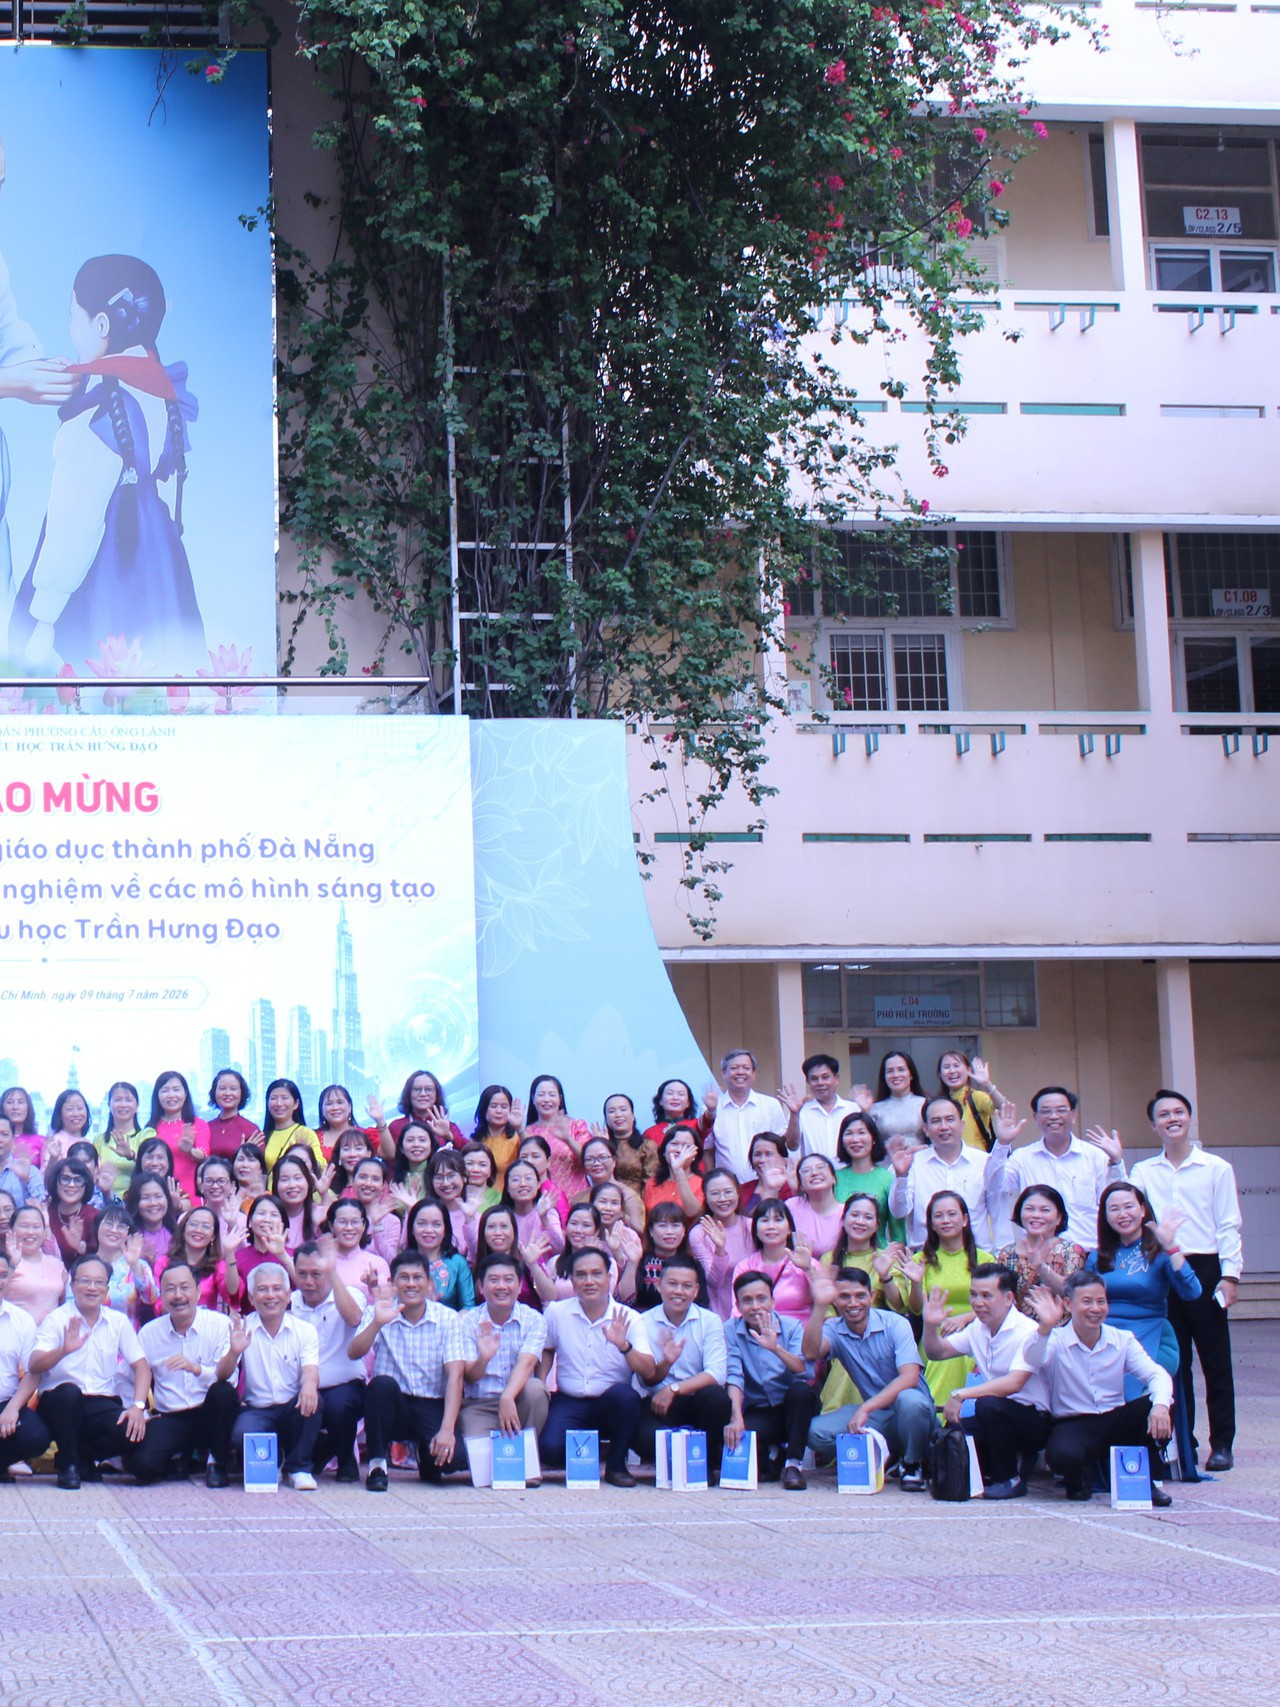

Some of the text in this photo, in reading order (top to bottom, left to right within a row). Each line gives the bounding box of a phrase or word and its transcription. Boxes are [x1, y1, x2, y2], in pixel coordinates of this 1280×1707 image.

[1195, 208, 1229, 221] C2.13
[1217, 222, 1241, 234] 2/5
[1223, 590, 1258, 603] C1.08
[1245, 605, 1271, 617] 2/3
[16, 741, 45, 754] HỌC
[87, 740, 125, 752] HƯNG
[129, 741, 159, 754] ĐẠO
[42, 772, 159, 813] MỪNG
[55, 838, 105, 865] dục
[111, 837, 193, 860] thành
[201, 832, 255, 864] phố
[258, 837, 297, 860] Đà
[304, 833, 375, 864] Nẵng
[3, 877, 103, 905] nghiệm
[110, 872, 141, 899] về
[148, 876, 197, 899] các
[204, 877, 244, 899] mô
[251, 877, 309, 899] hình
[317, 876, 382, 904] sáng
[389, 879, 436, 903] tạo
[18, 918, 67, 944] học
[74, 912, 140, 940] Trần
[148, 918, 218, 944] Hưng
[225, 917, 281, 943] Đạo
[0, 990, 18, 1001] Chí
[52, 990, 77, 1003] ngày
[79, 990, 94, 1001] 09
[95, 990, 125, 1003] tháng
[128, 989, 135, 1000] 7
[136, 990, 159, 1000] năm
[161, 989, 189, 1000] 2026
